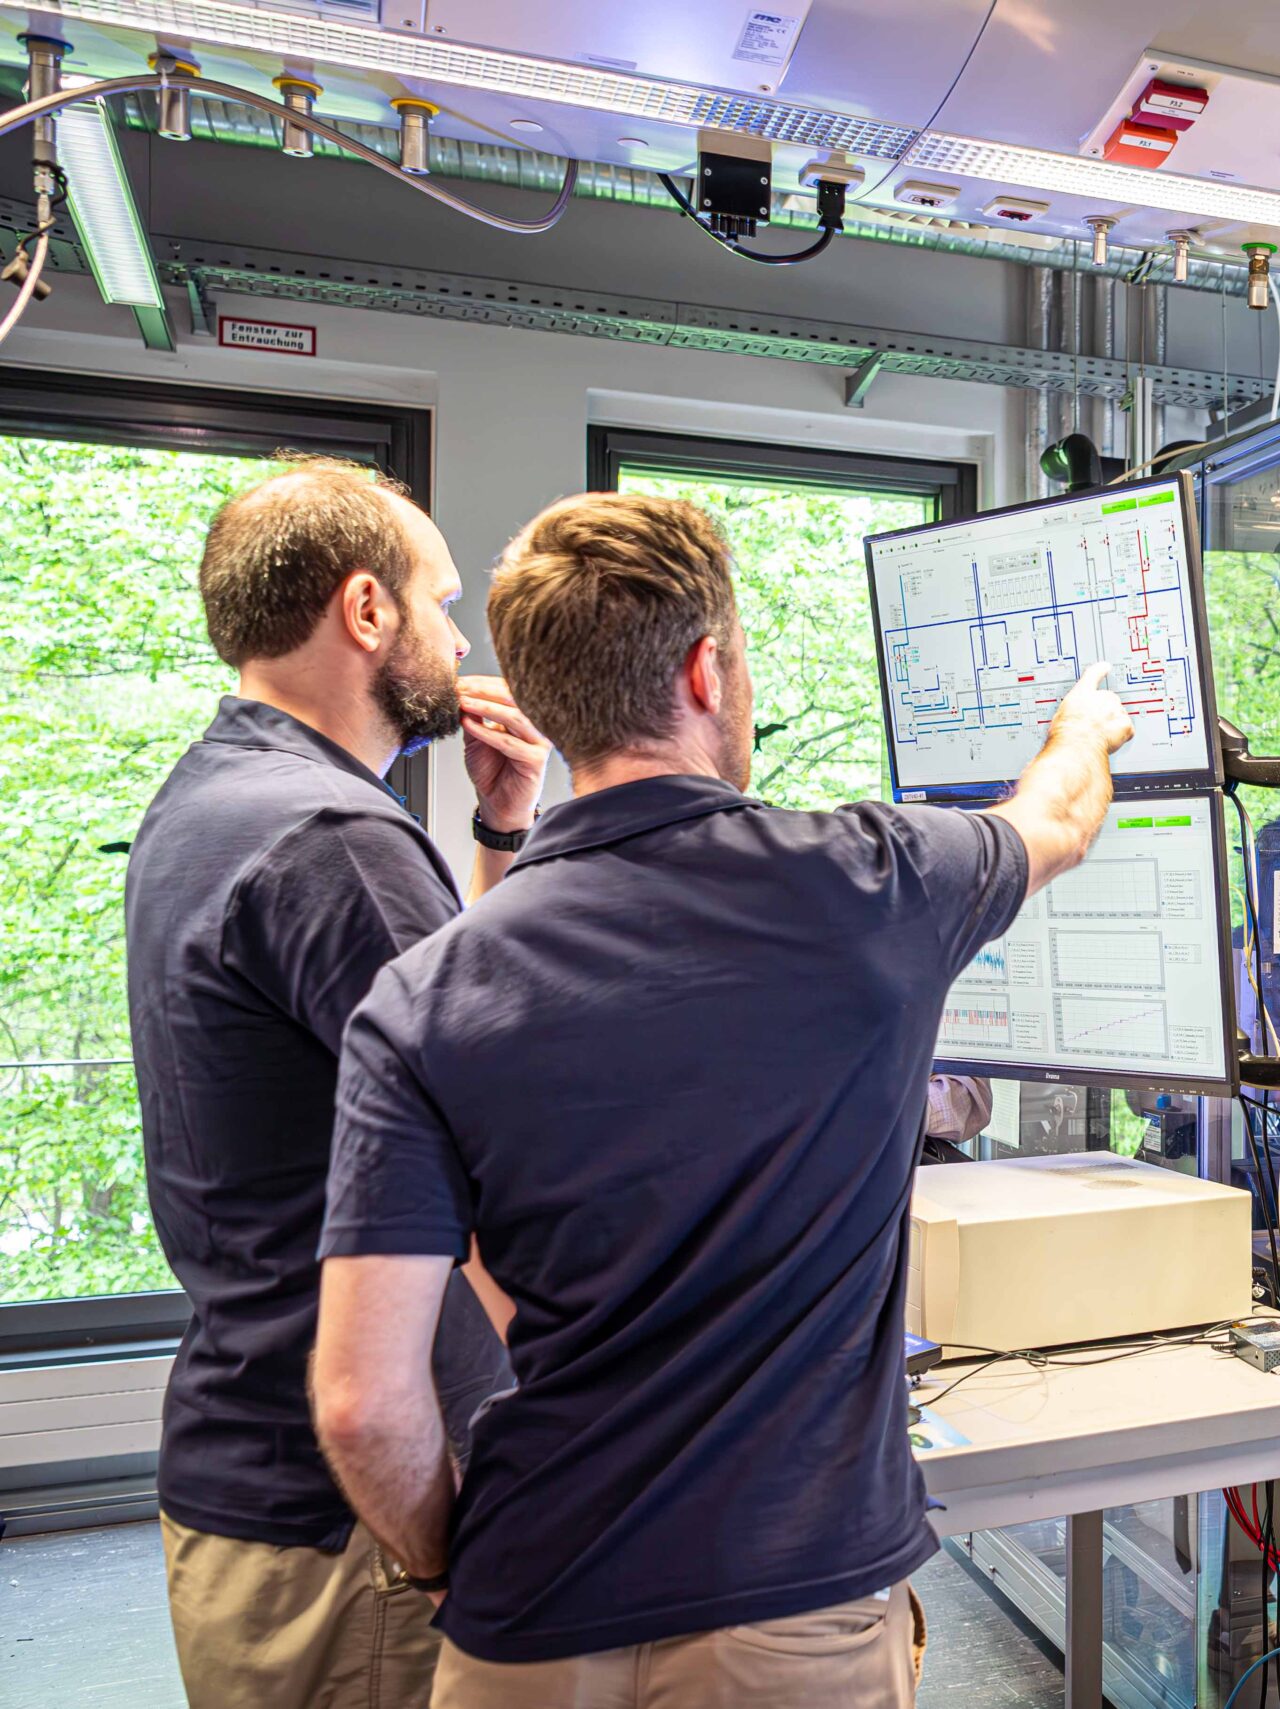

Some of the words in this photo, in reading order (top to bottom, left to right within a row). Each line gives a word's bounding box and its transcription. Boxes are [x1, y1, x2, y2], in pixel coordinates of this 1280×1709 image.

[231, 323, 278, 336] Fenster
[284, 330, 304, 339] zur
[231, 333, 304, 351] Entrauchung
